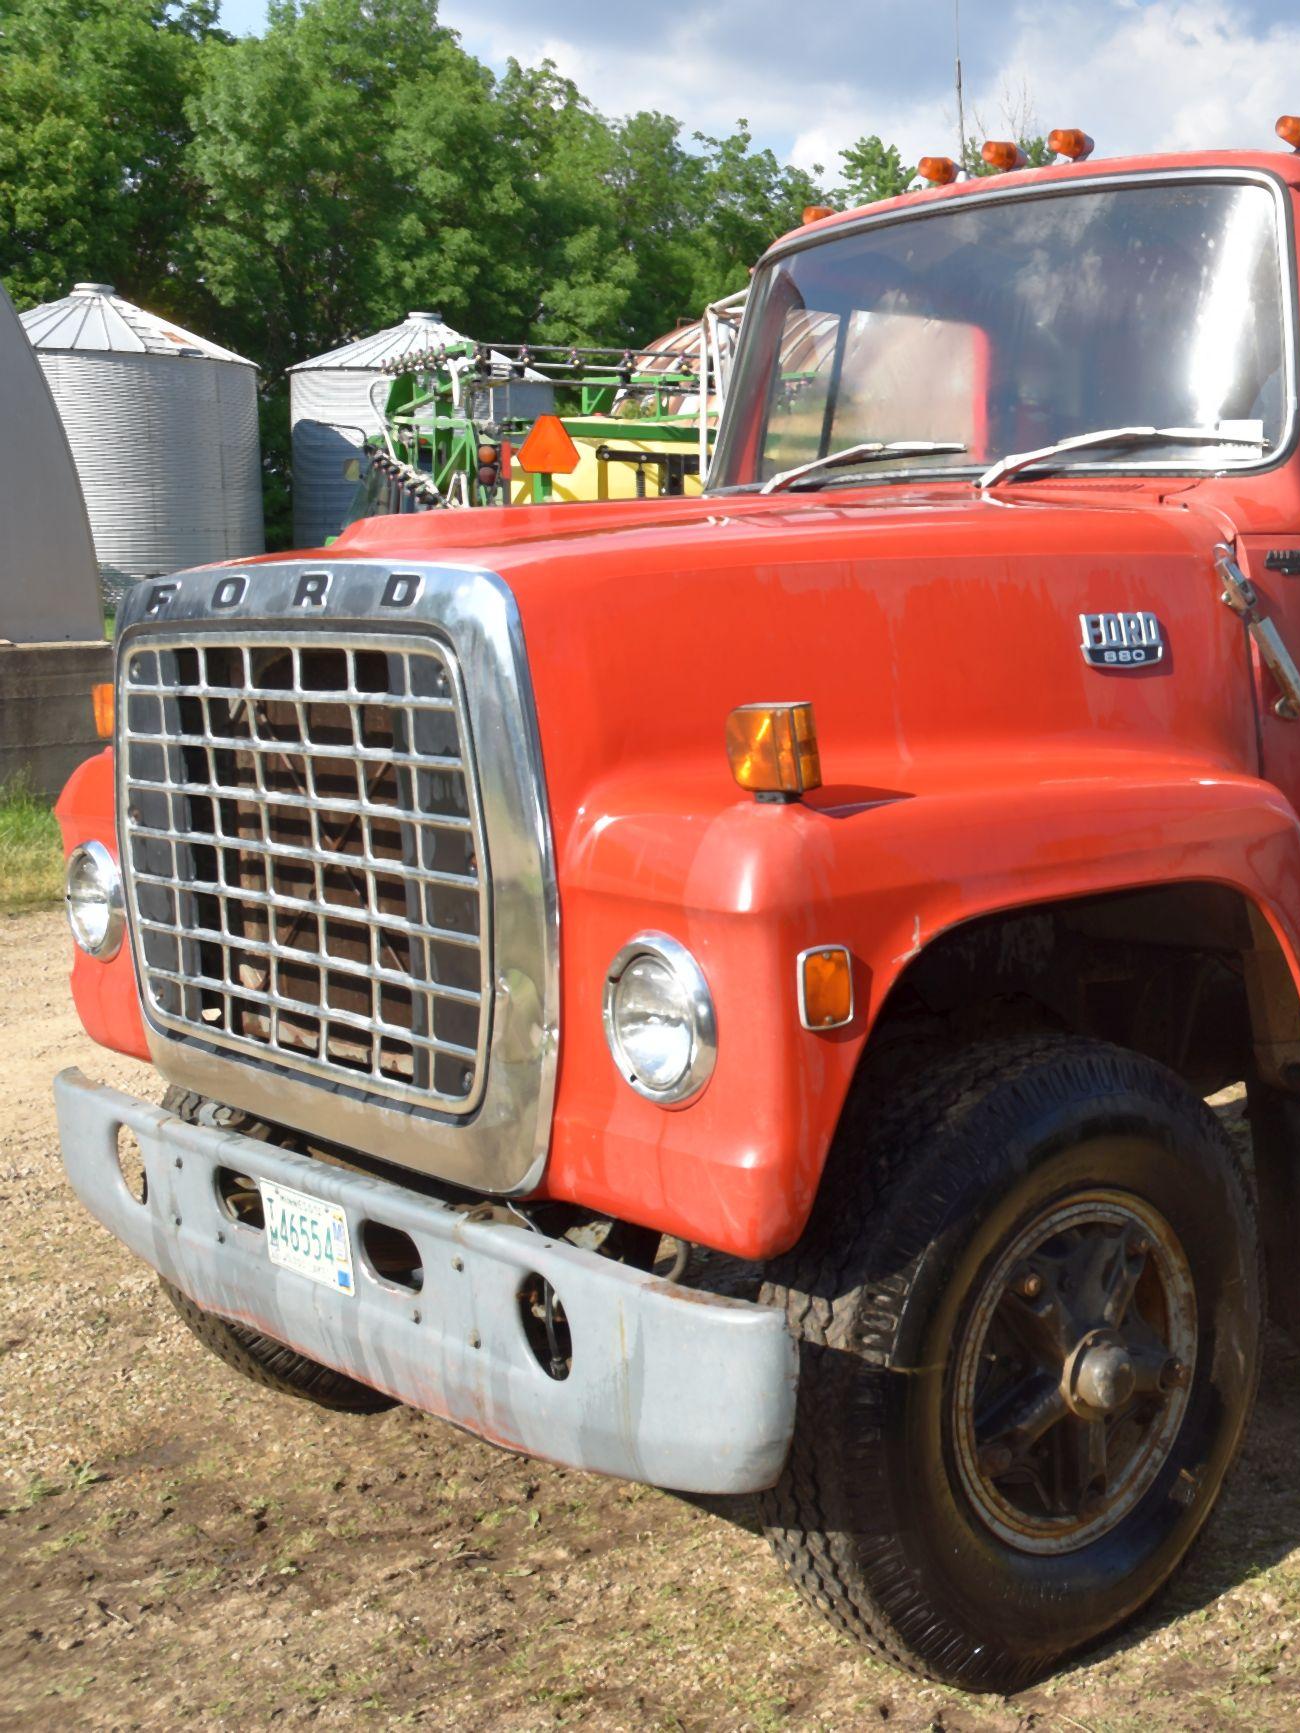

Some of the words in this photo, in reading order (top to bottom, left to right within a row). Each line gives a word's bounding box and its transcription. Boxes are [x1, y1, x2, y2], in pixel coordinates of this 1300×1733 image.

[147, 573, 426, 614] FORD
[1079, 611, 1161, 648] FORD
[279, 1208, 335, 1264] 46554
